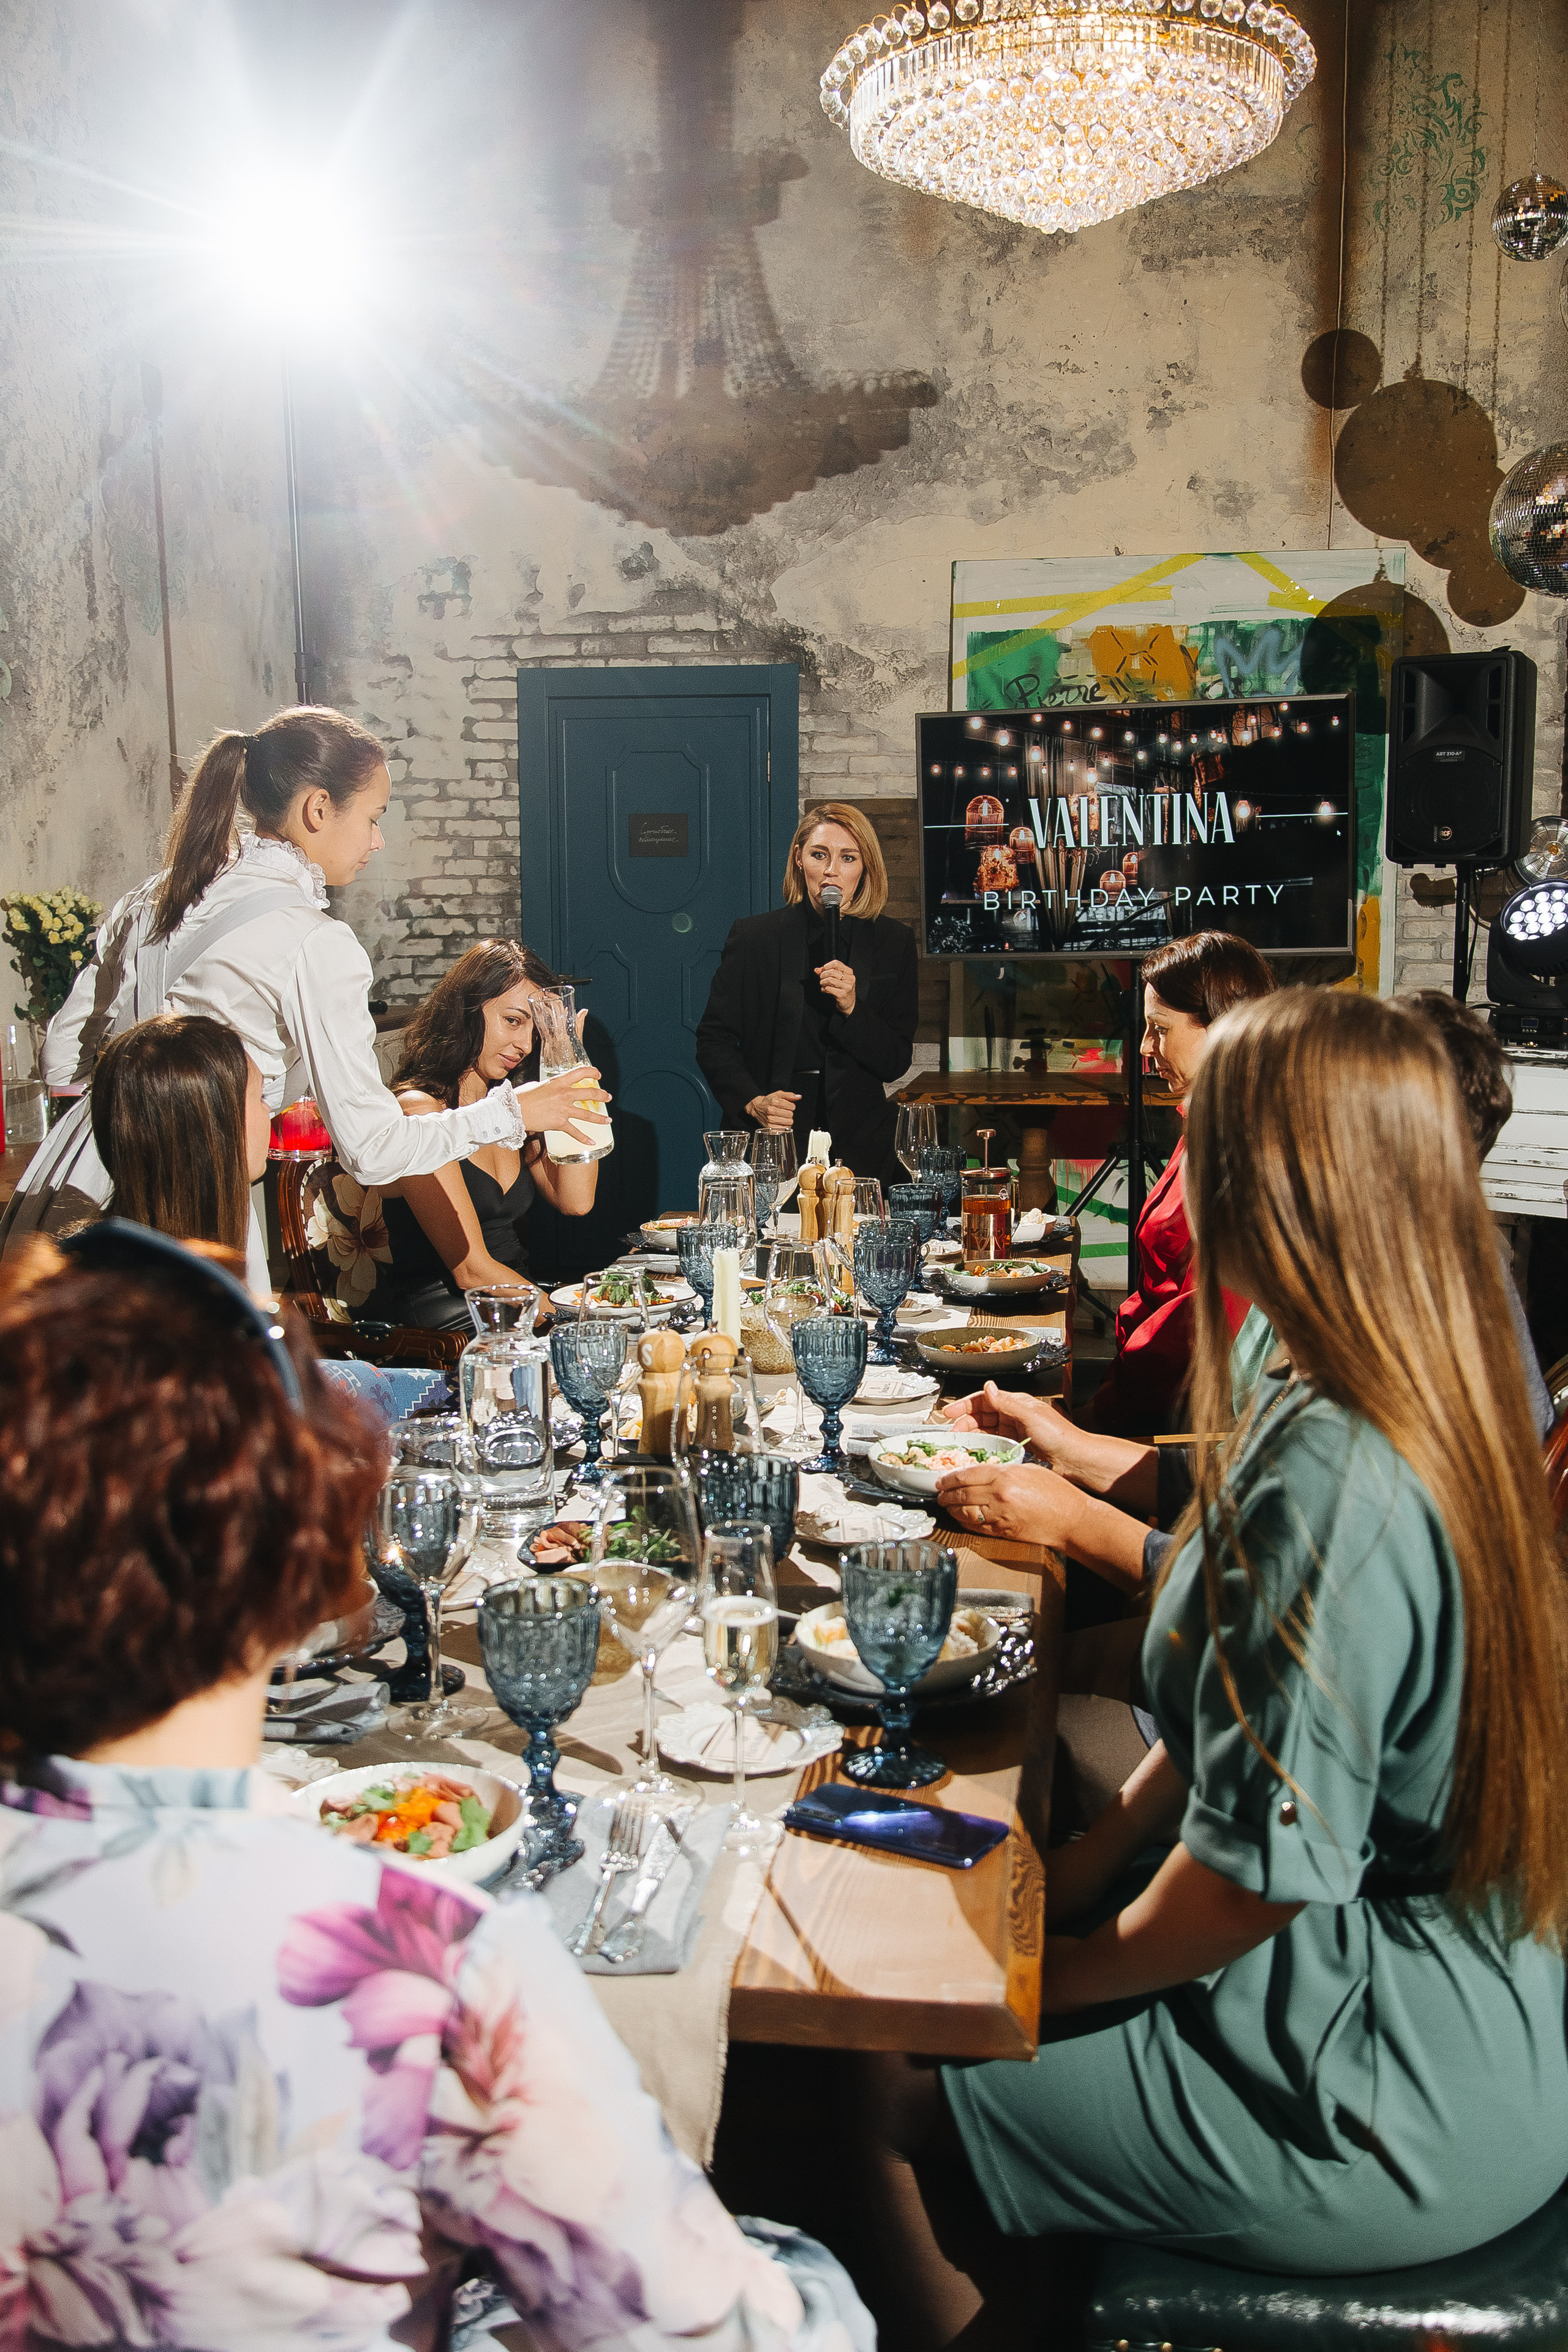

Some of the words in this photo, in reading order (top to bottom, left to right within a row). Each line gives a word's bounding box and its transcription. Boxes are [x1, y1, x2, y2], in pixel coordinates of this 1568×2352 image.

[1028, 791, 1235, 849] VALENTINA
[983, 887, 1155, 910] BIRTHDAY
[1175, 884, 1284, 907] PARTY
[641, 1343, 654, 1366] S
